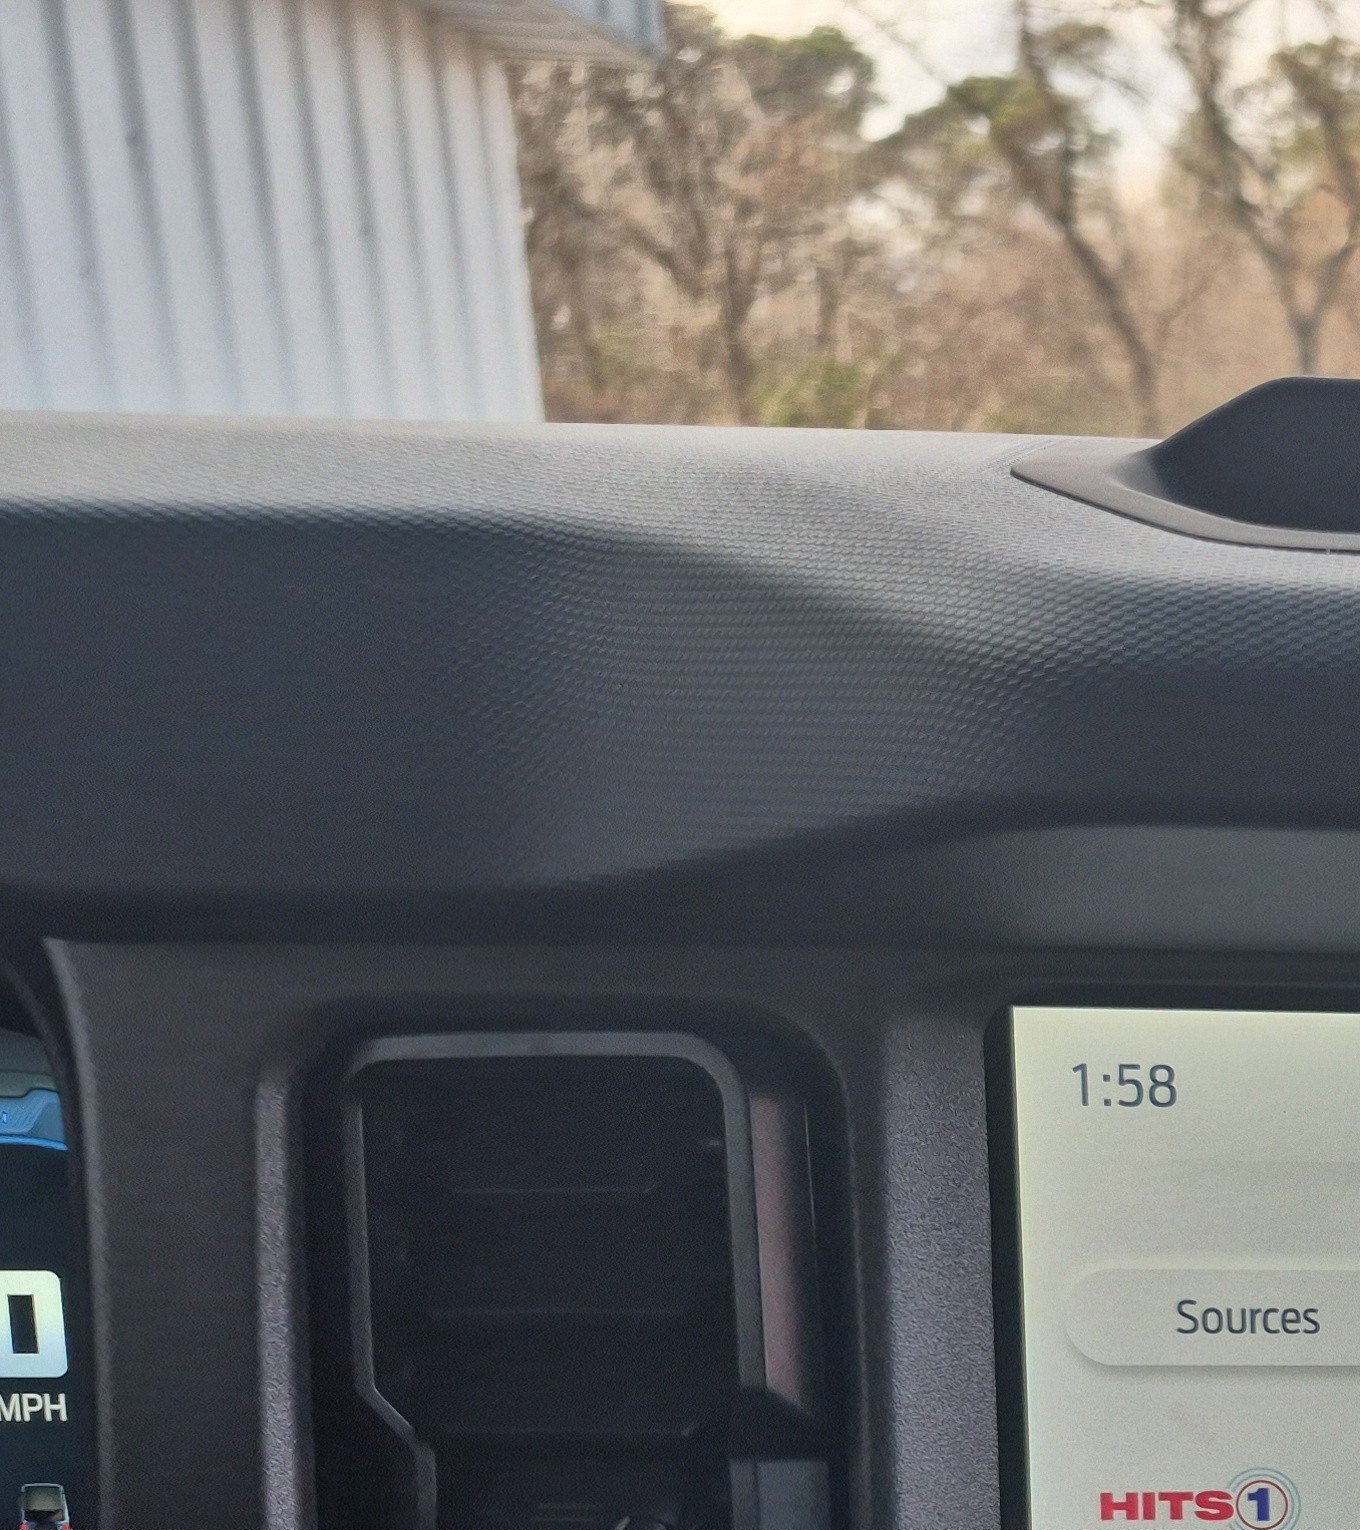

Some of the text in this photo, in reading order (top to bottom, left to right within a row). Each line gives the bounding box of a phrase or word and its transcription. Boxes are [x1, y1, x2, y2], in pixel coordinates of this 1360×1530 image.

[1072, 1062, 1177, 1108] 1:58
[1176, 1299, 1321, 1335] Sources
[0, 1393, 68, 1423] MPH
[1100, 1487, 1270, 1521] HITS 1
